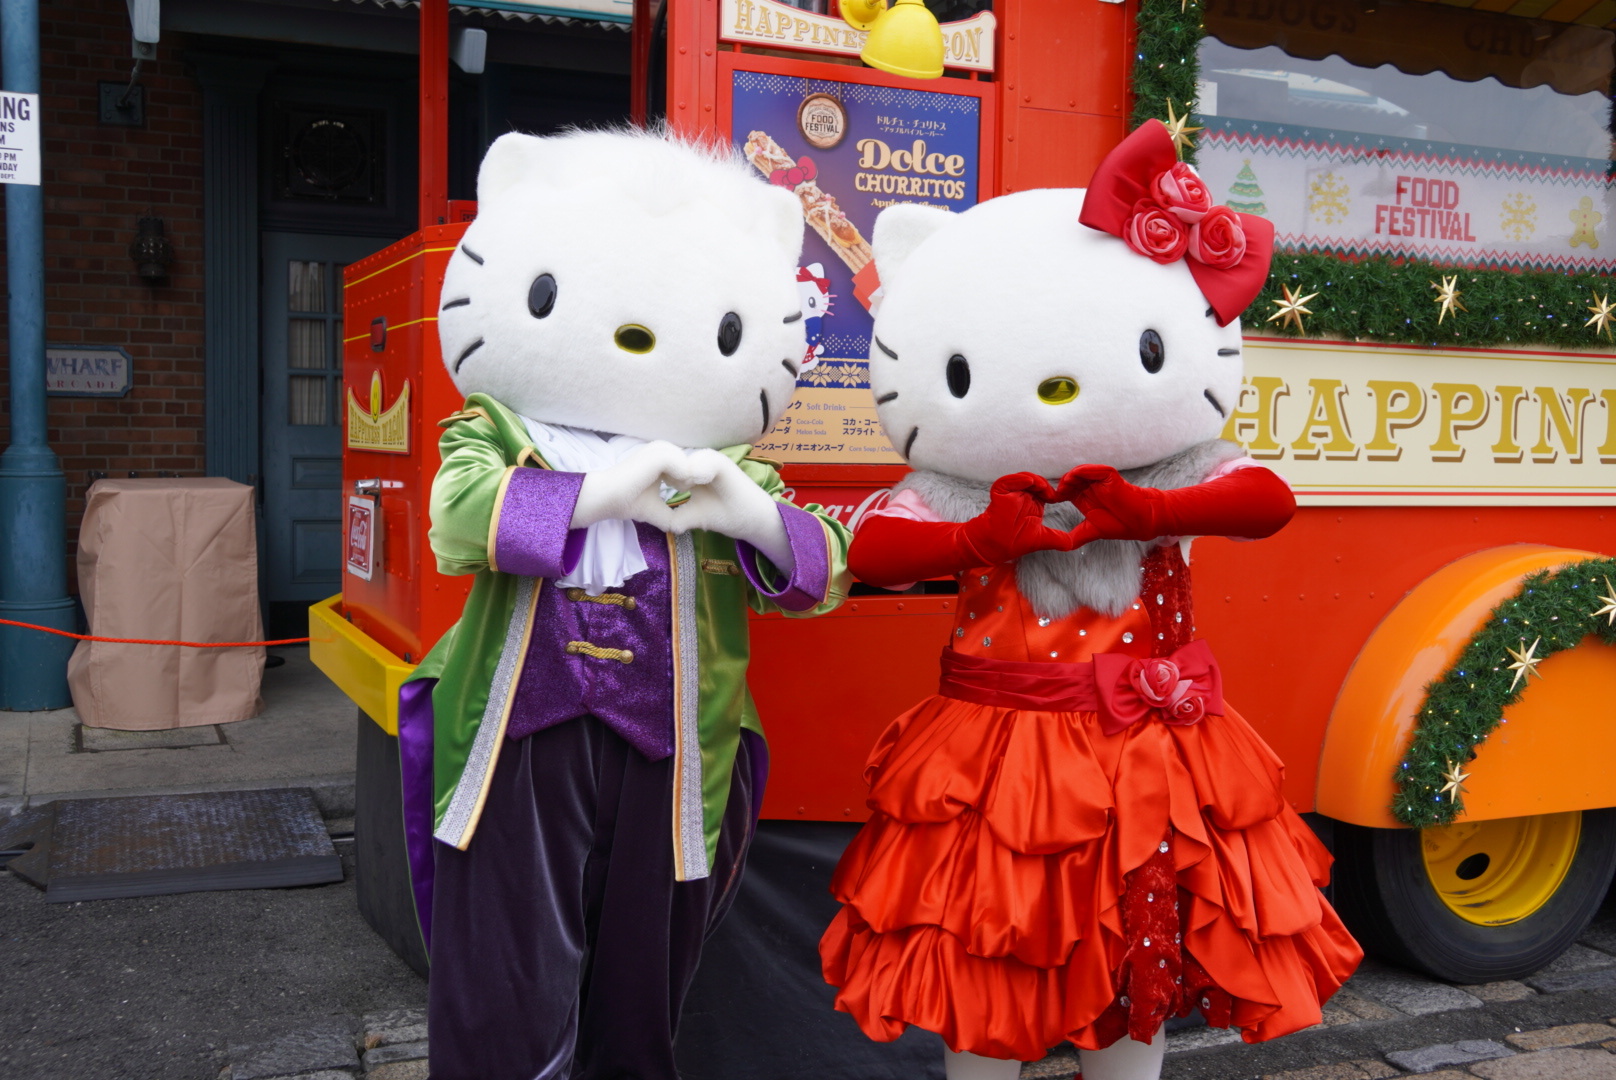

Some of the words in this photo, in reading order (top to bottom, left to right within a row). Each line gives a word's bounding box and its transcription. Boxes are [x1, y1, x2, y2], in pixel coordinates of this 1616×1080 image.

[811, 114, 833, 124] FOOD
[876, 115, 947, 131] ドルチェ・チュリトス
[805, 122, 839, 133] FESTIVAL
[856, 138, 965, 177] Dolce
[855, 172, 965, 201] CHURRITOS
[1396, 175, 1460, 211] FOOD
[1375, 203, 1477, 243] FESTIVAL
[806, 403, 821, 411] Soft
[823, 403, 846, 411] Drinks
[842, 418, 881, 426] コカ・コー
[842, 427, 875, 436] スプライト
[796, 443, 845, 452] オニオンスープ
